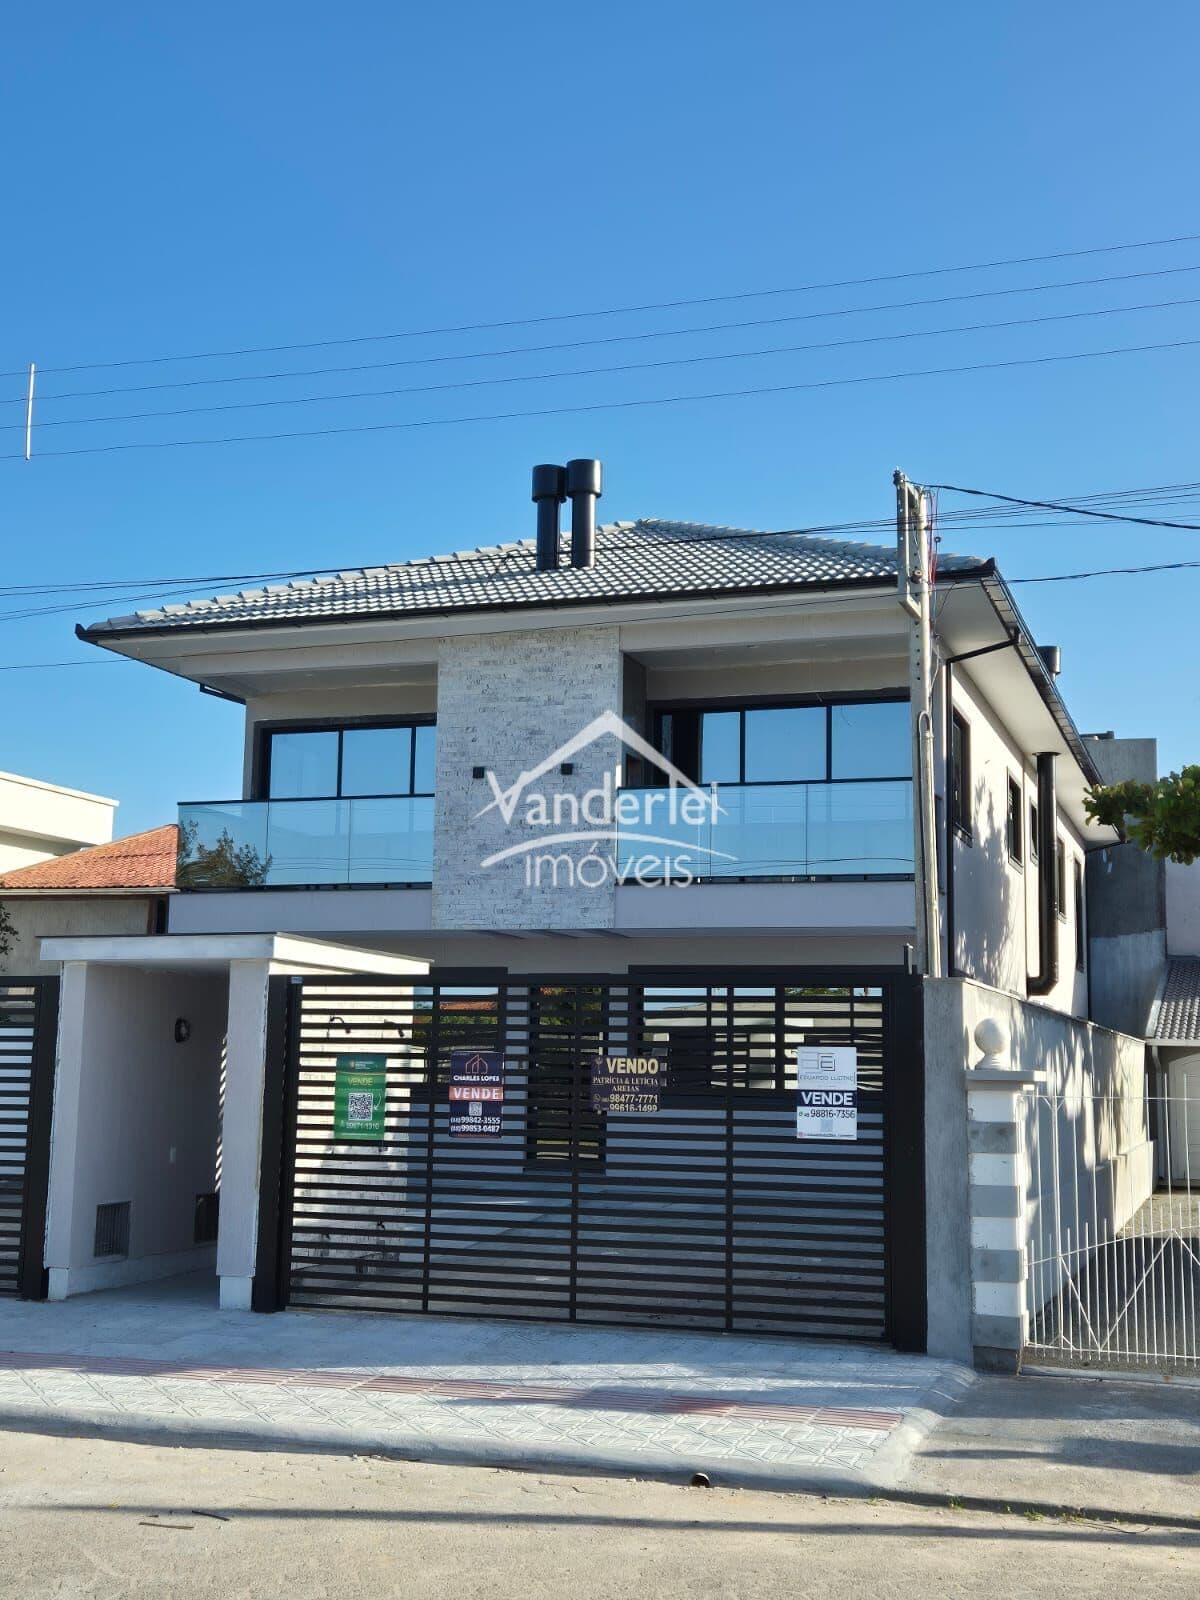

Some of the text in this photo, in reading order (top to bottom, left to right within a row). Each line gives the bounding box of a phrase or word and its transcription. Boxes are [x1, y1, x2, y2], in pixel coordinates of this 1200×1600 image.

[606, 1057, 659, 1074] VENDO
[592, 1076, 623, 1085] PATRÍCIA
[631, 1076, 658, 1086] LETÍCIA
[453, 1087, 500, 1100] VENDE
[609, 1094, 658, 1103] 98477-7771
[801, 1091, 854, 1106] VENDE
